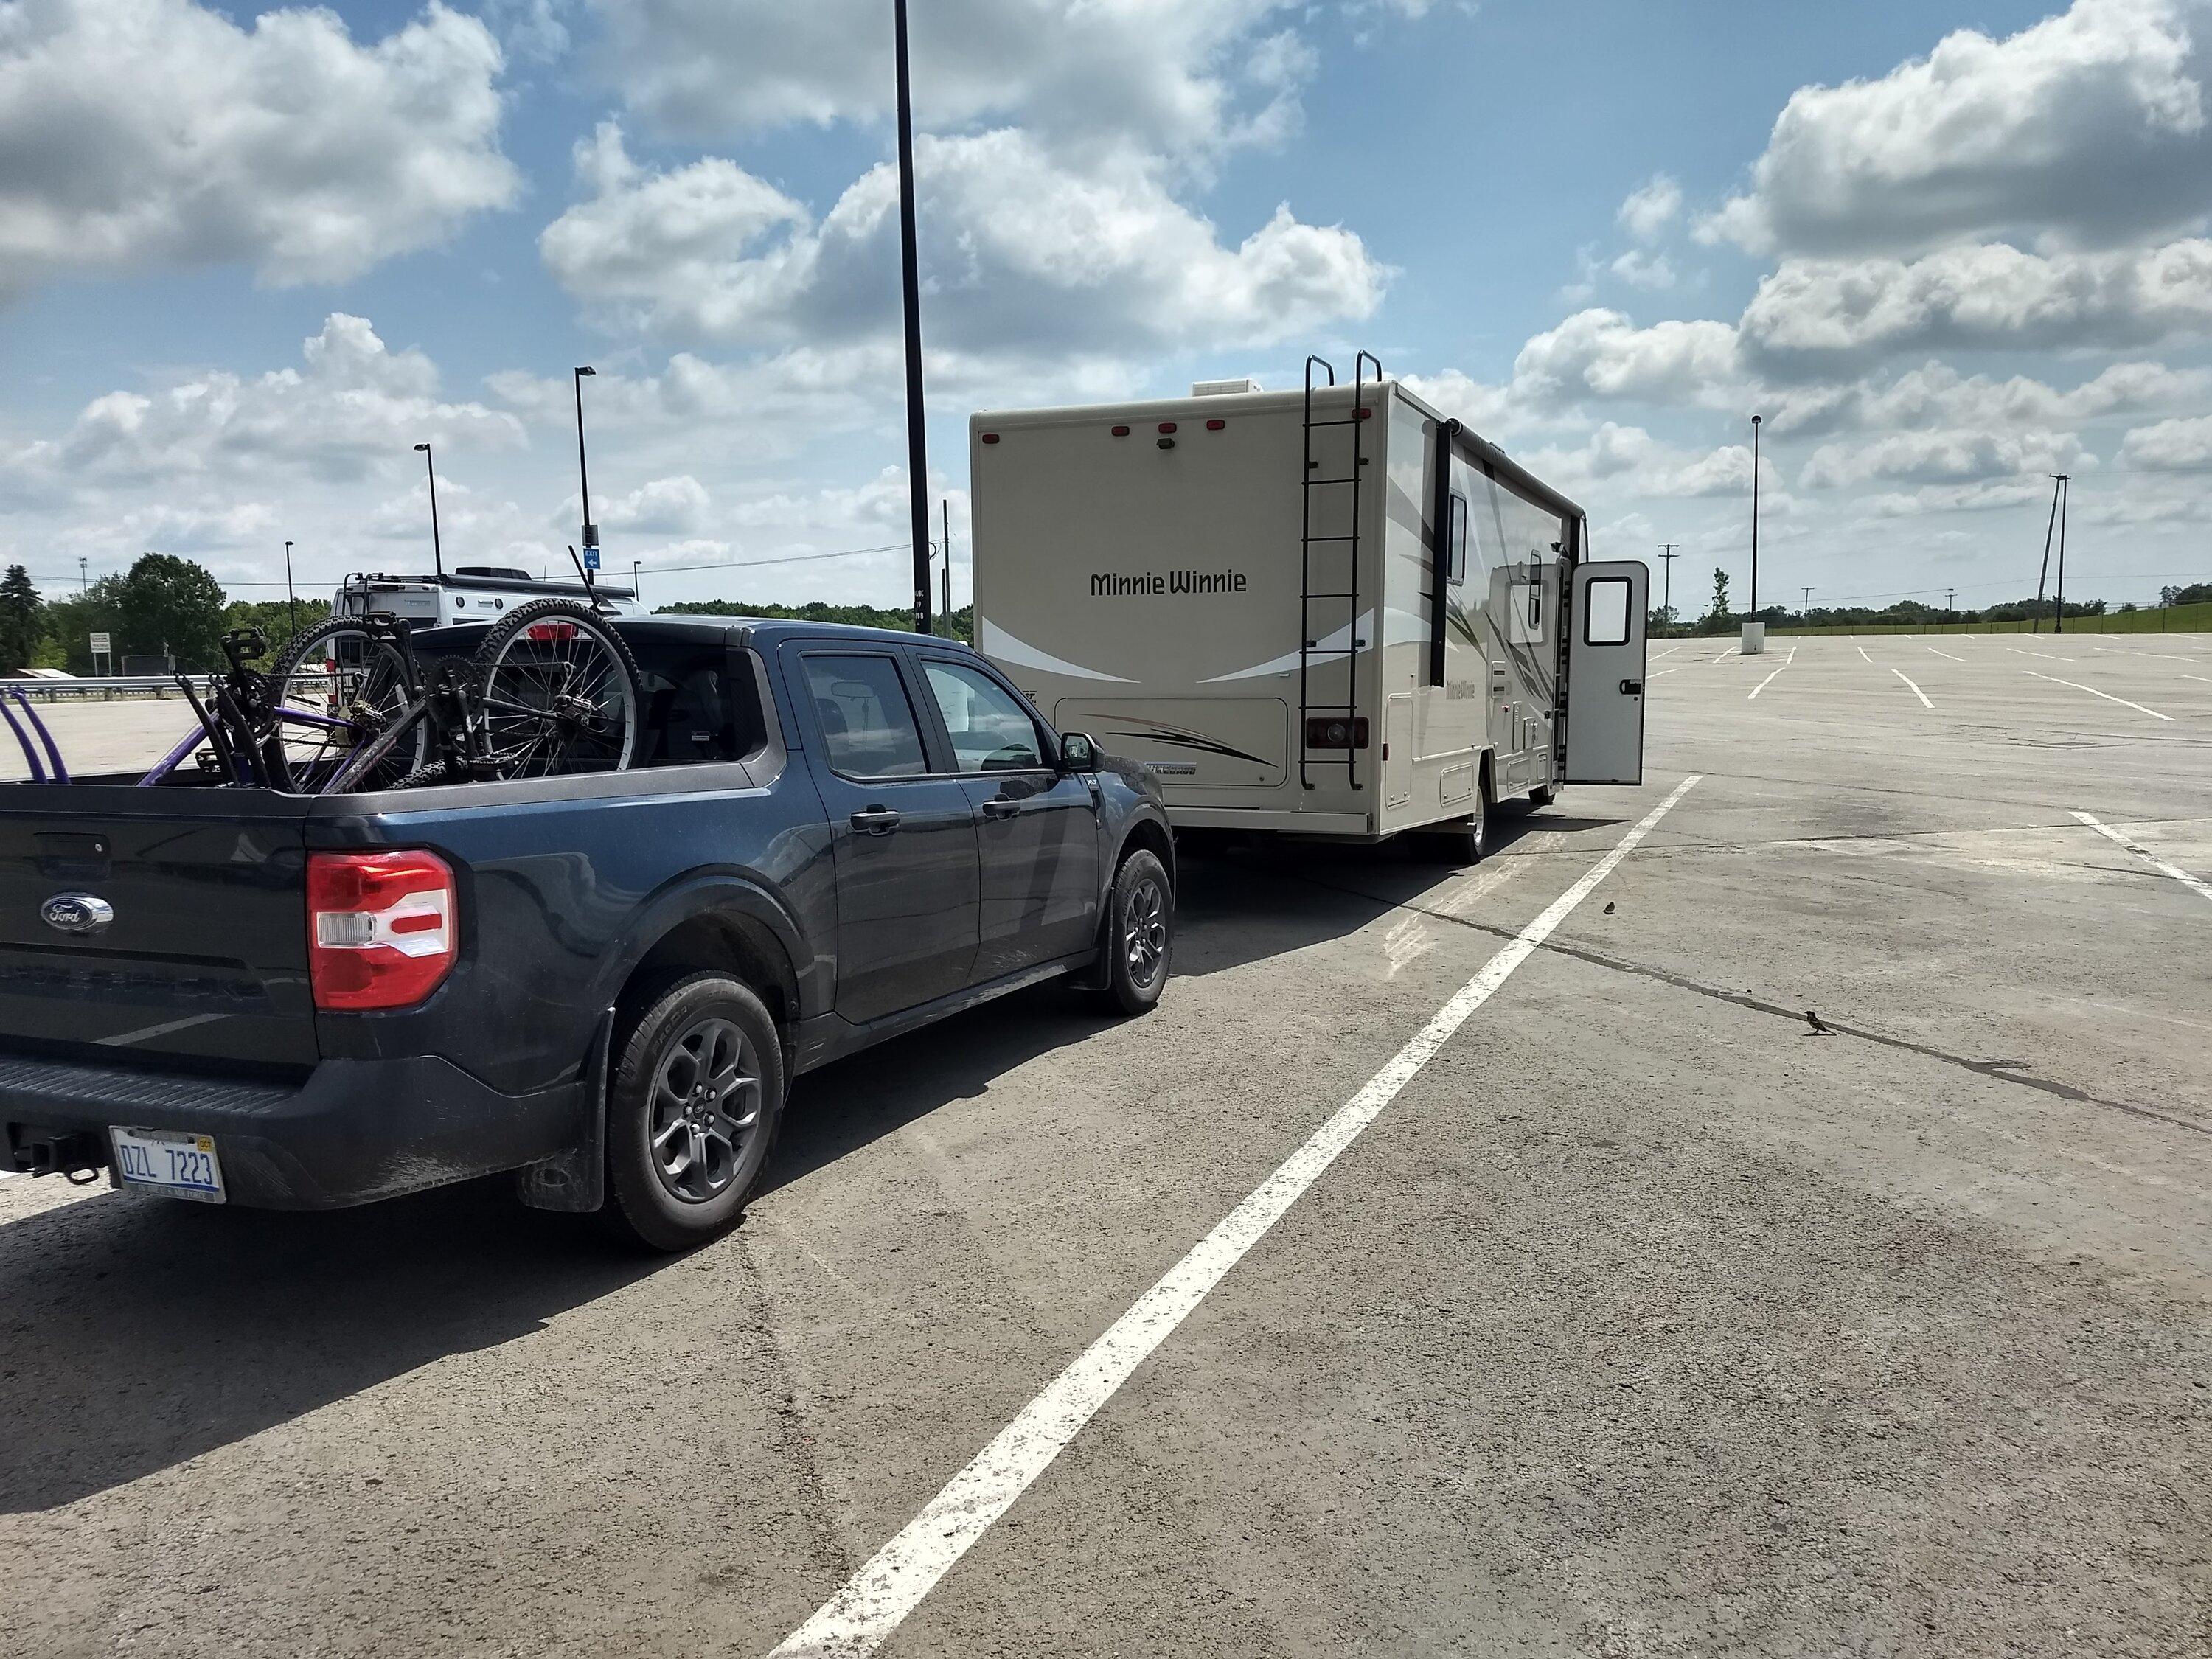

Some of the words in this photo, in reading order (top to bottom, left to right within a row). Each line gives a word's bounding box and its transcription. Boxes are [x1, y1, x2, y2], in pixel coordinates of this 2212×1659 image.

[1091, 571, 1165, 596] Minnie
[1169, 568, 1247, 594] Winnie
[49, 903, 81, 922] Ford
[120, 1144, 157, 1178] DZL
[165, 1149, 213, 1185] 7223
